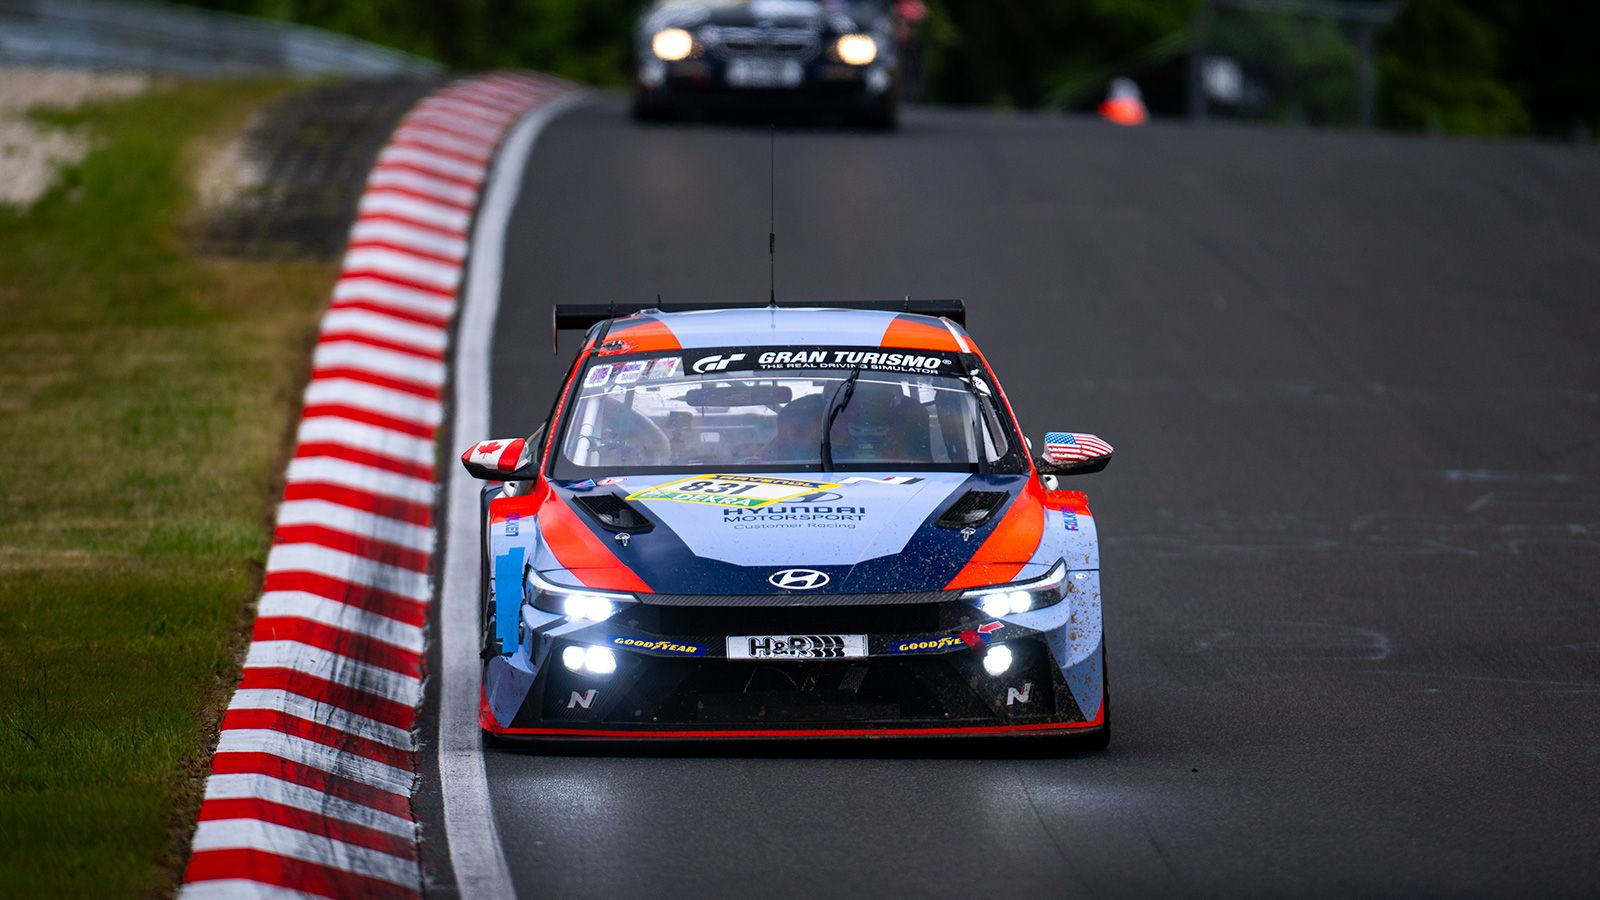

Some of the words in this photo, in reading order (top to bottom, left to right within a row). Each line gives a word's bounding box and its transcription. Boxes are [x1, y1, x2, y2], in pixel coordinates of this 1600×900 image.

[758, 351, 827, 364] GRAN
[870, 364, 938, 374] SIMULATOR
[679, 480, 759, 495] 831
[673, 493, 751, 506] DEKRA
[723, 507, 866, 515] HYUNDAI
[724, 514, 866, 523] MOTORSPORT
[734, 522, 803, 530] Customer
[807, 522, 856, 530] Racing
[614, 637, 697, 654] GOODYEAR
[899, 637, 964, 651] GOODYE
